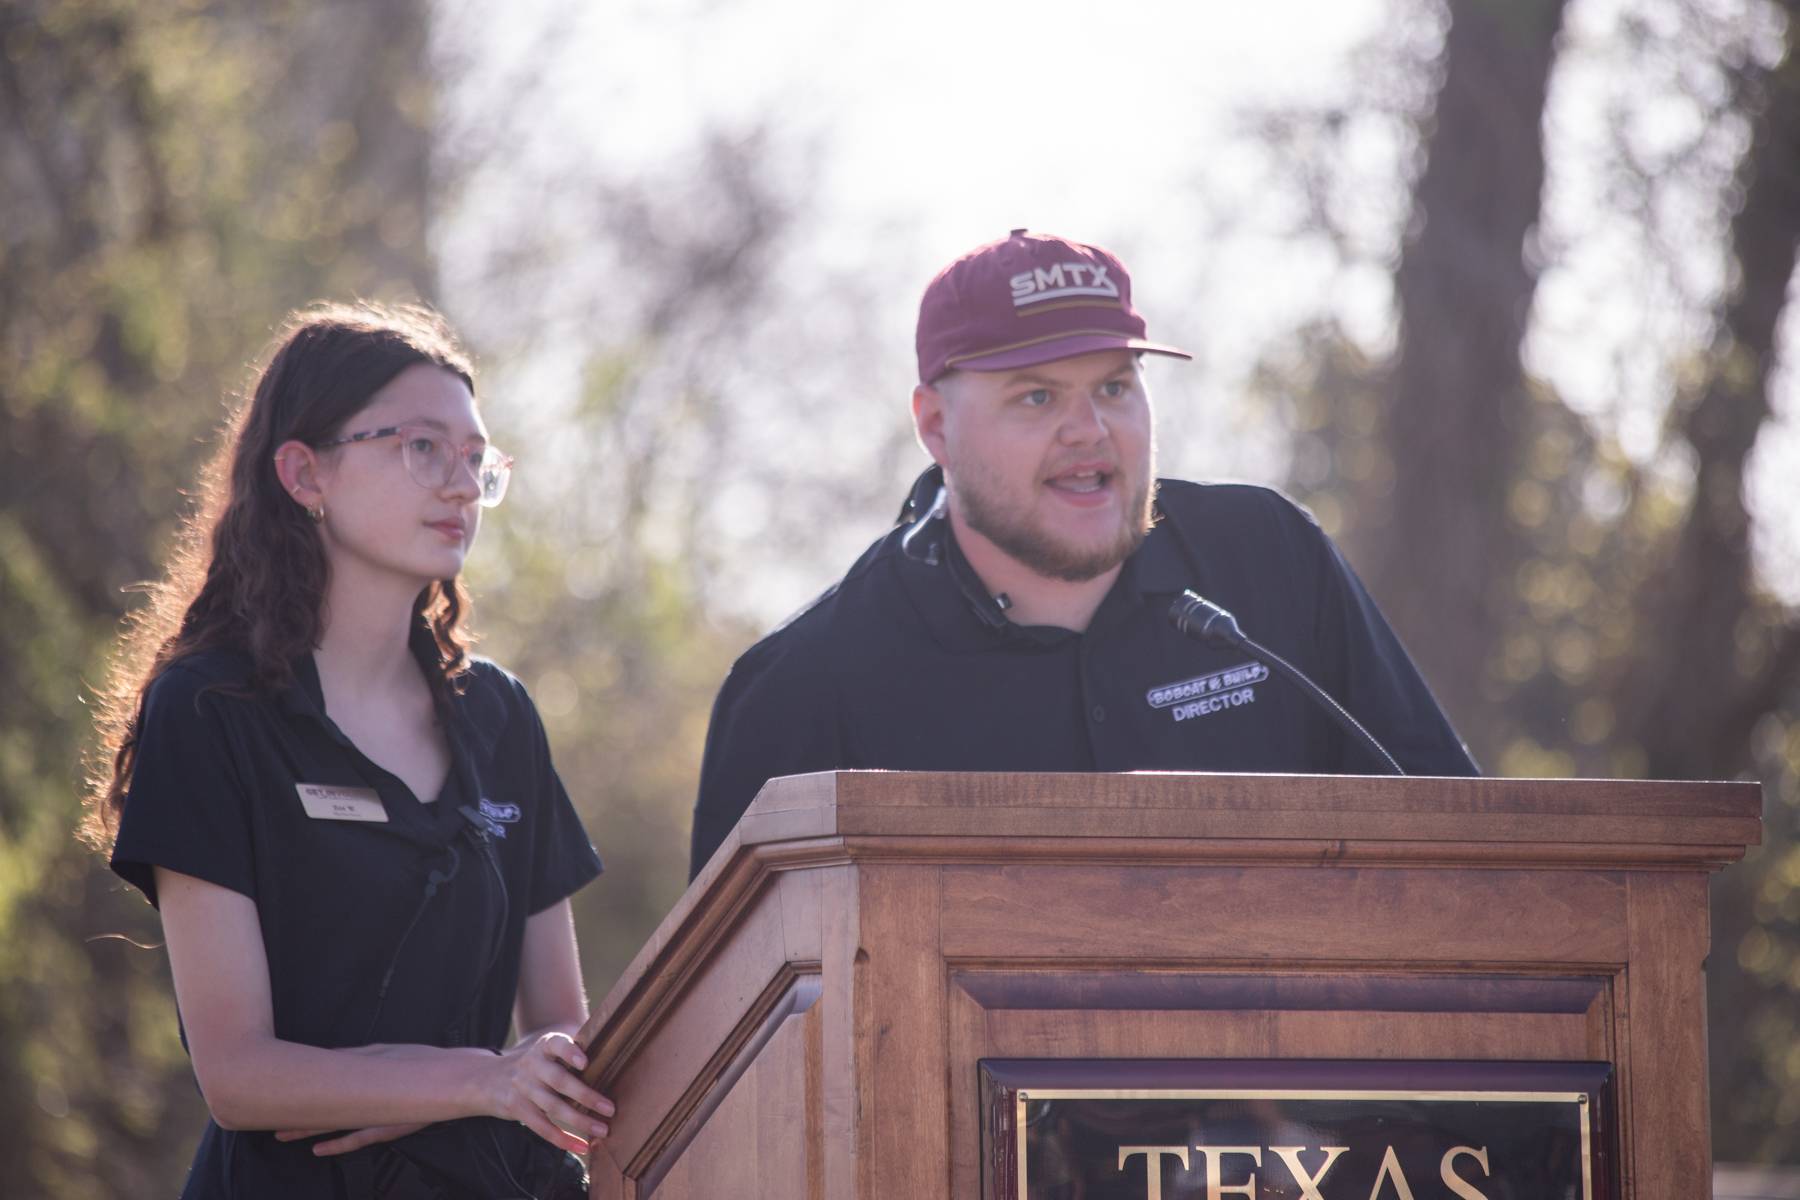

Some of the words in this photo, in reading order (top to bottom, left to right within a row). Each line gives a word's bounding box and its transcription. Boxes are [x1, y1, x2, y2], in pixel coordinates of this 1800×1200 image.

[1010, 262, 1117, 298] SMTX
[1152, 680, 1207, 704] BOBCAT
[1172, 687, 1256, 721] DIRECTOR
[1118, 1145, 1490, 1200] TEXAS
